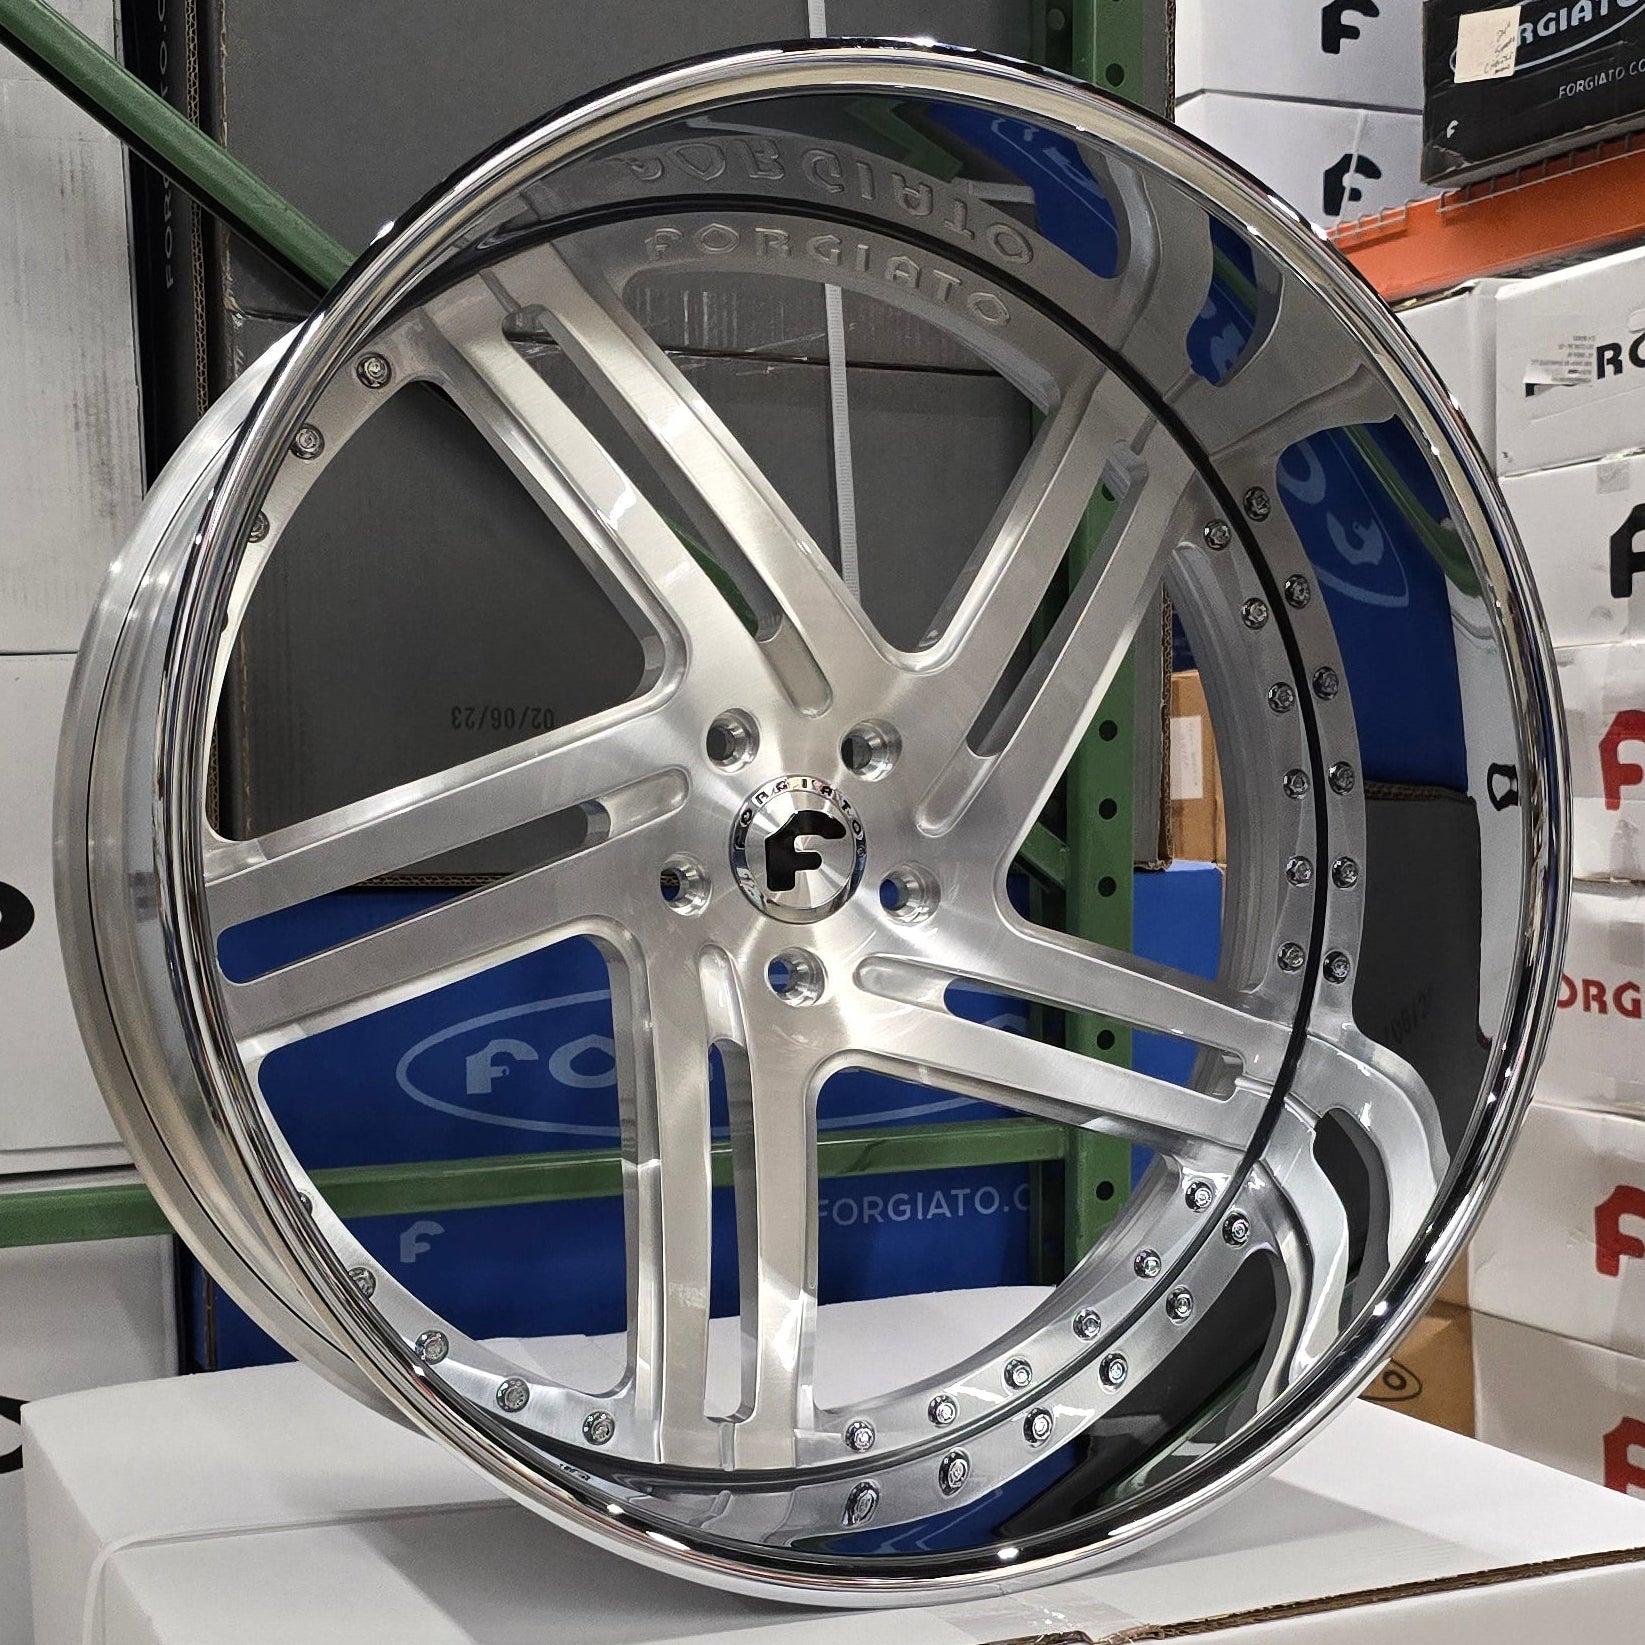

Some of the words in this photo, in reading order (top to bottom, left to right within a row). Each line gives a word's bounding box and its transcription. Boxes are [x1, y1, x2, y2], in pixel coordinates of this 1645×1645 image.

[1558, 66, 1625, 99] FORGIATO
[645, 223, 1011, 327] FORGIATO
[765, 810, 846, 891] F
